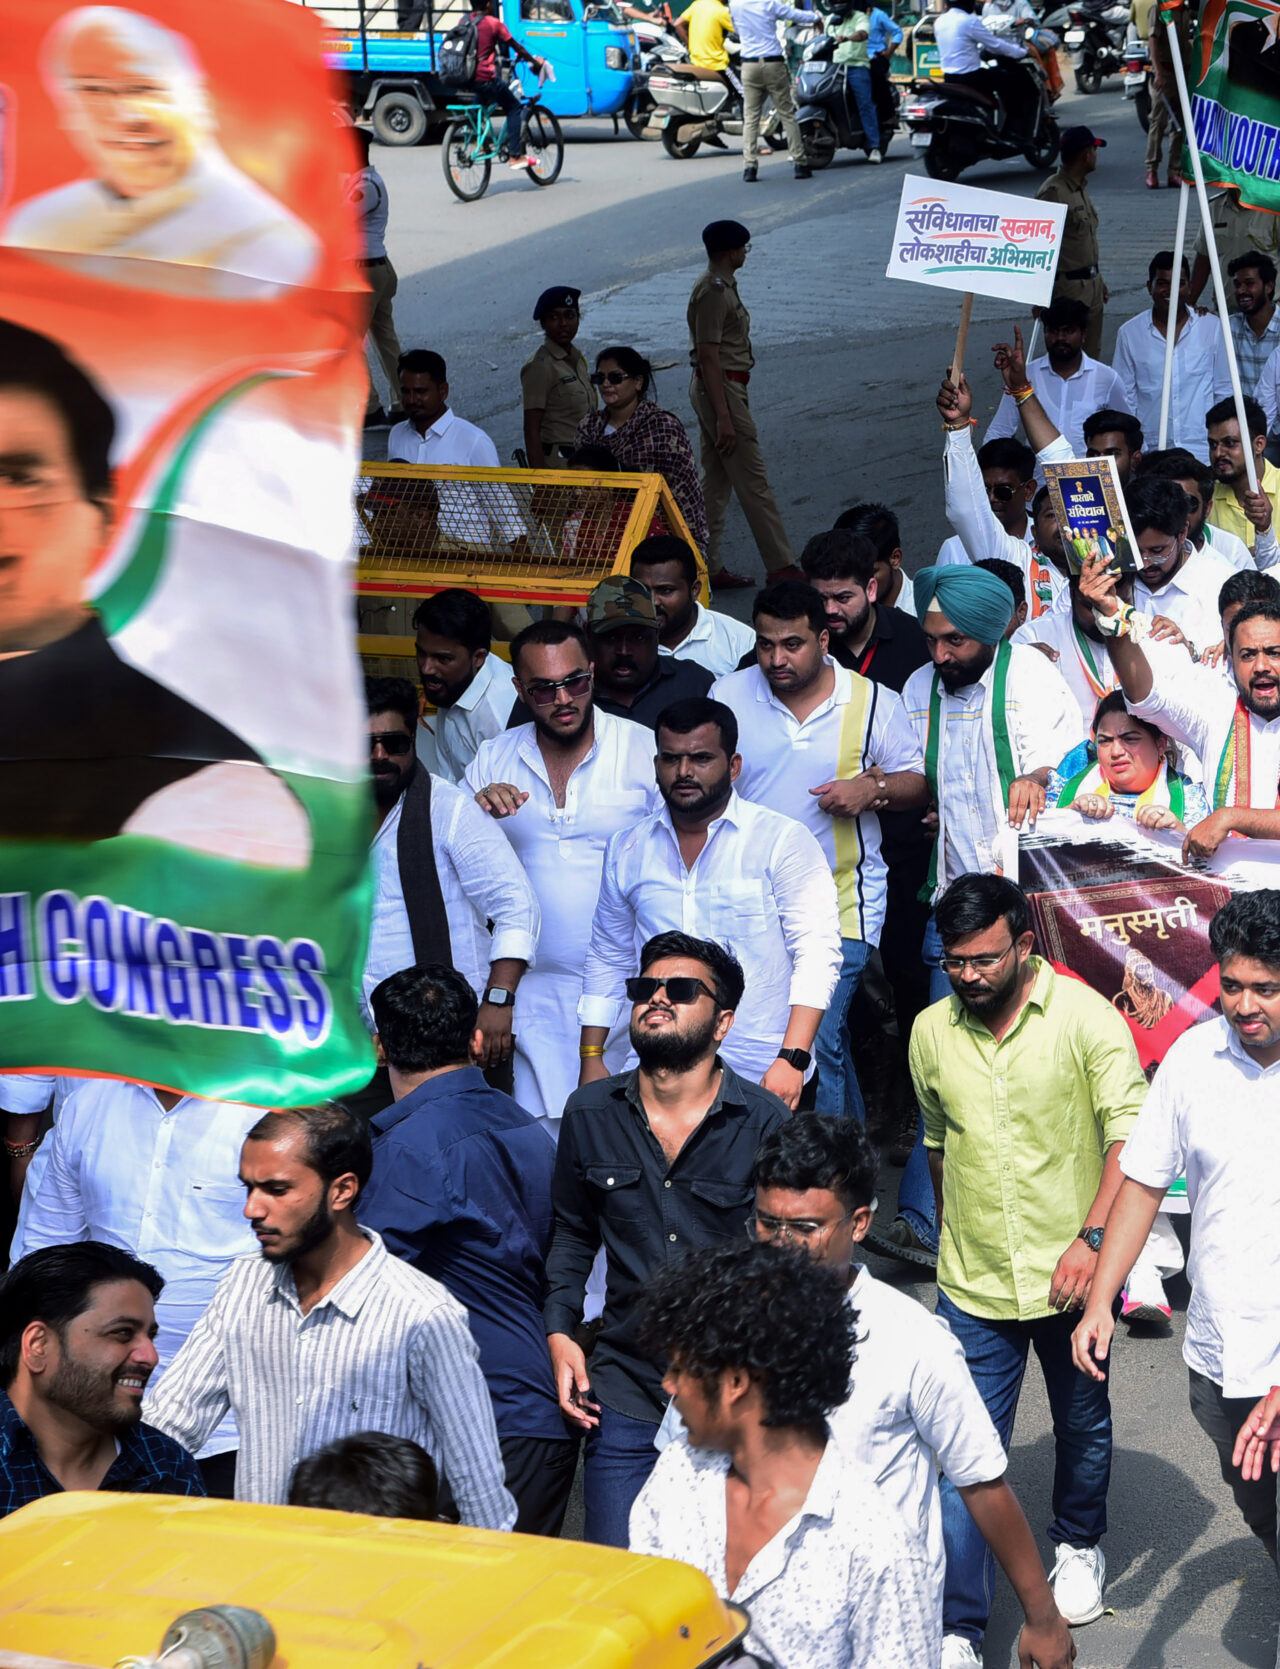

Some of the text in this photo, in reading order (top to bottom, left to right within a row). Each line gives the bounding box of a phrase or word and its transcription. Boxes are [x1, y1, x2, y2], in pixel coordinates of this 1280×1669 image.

[905, 203, 1056, 243] संविधानाचा सन्मान,
[899, 236, 1055, 271] लोकशाहीचा अभिमान!
[1067, 504, 1106, 518] संविधान
[1077, 896, 1199, 946] मनुस्मृती
[36, 889, 334, 1048] CONGRESS
